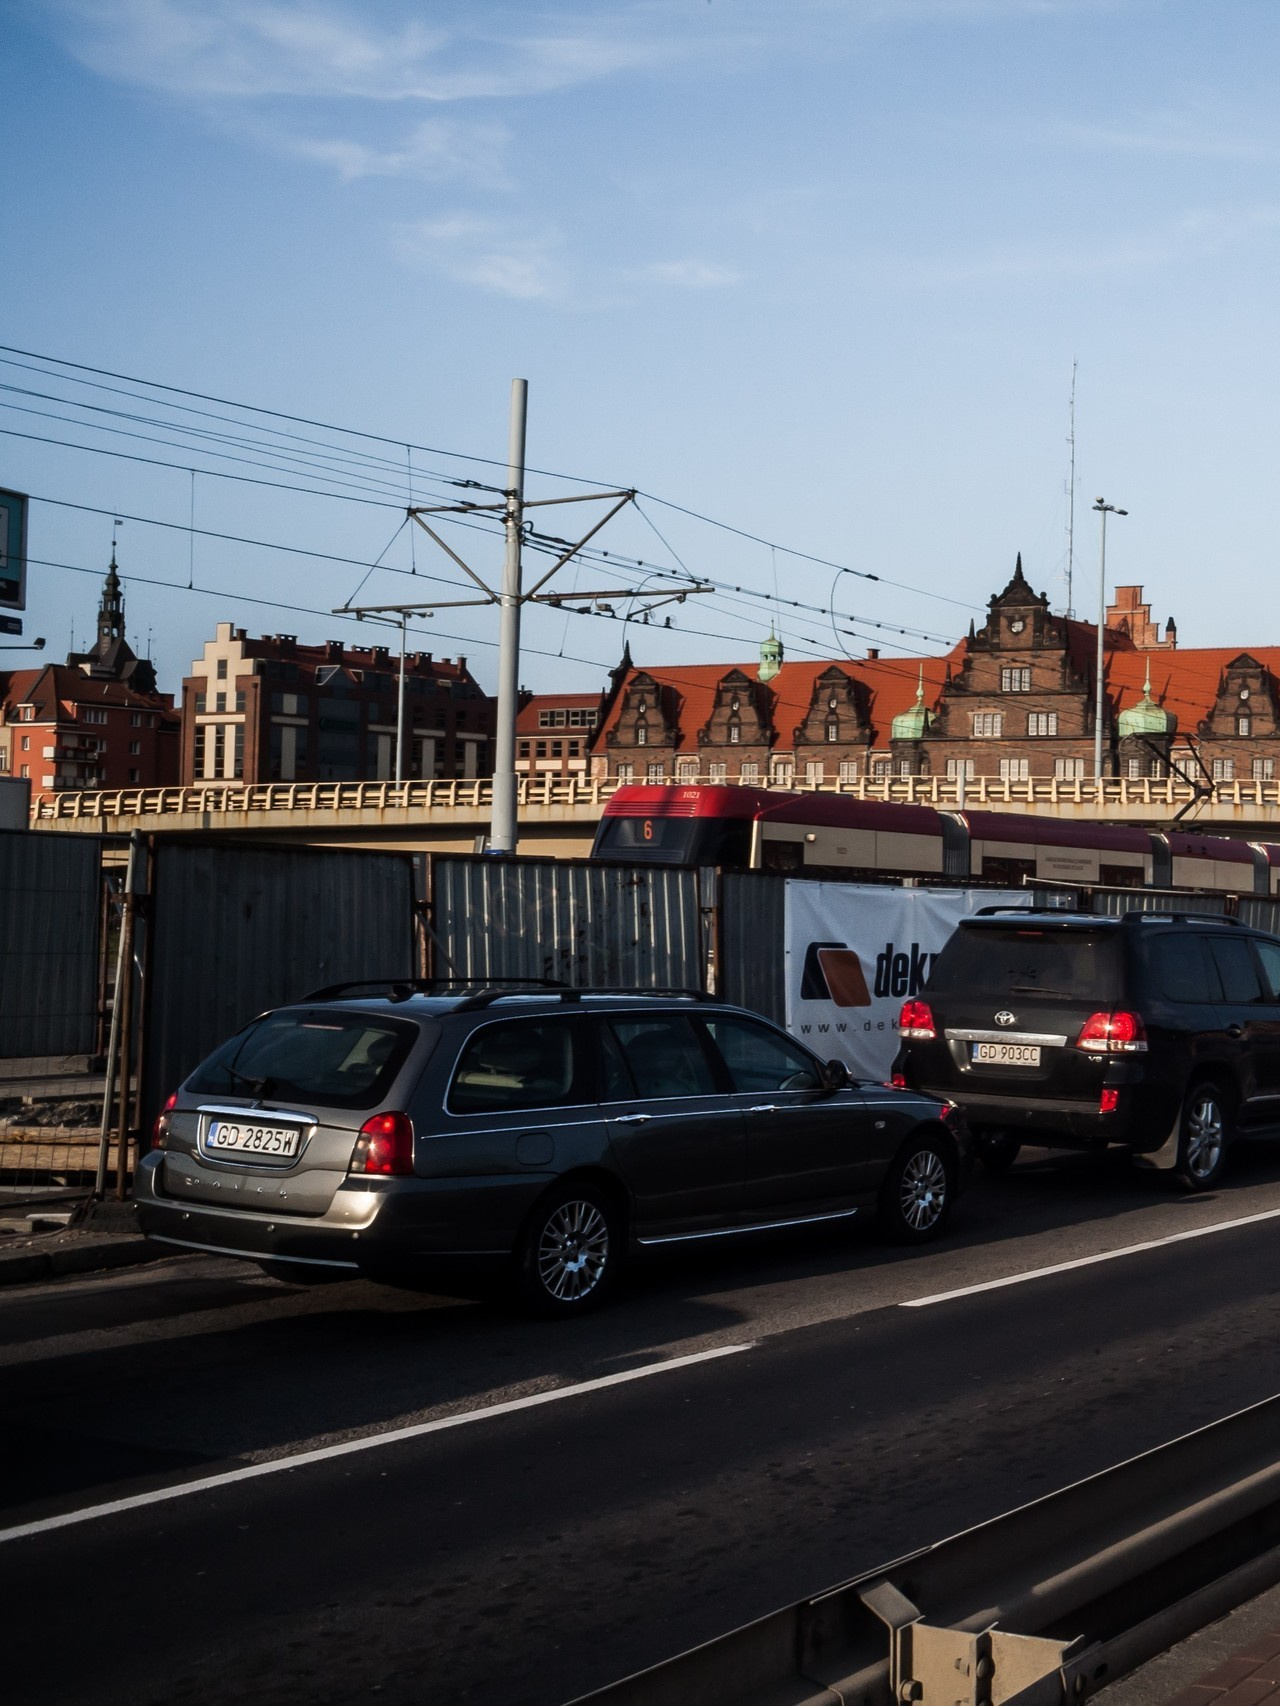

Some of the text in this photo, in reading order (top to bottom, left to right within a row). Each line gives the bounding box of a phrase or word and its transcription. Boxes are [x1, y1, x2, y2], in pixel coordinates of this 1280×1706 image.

[683, 791, 700, 799] 1021
[644, 820, 653, 840] 6
[980, 1045, 1038, 1061] GD 903CC
[1088, 1055, 1103, 1063] V8
[217, 1125, 295, 1153] GD 2825W
